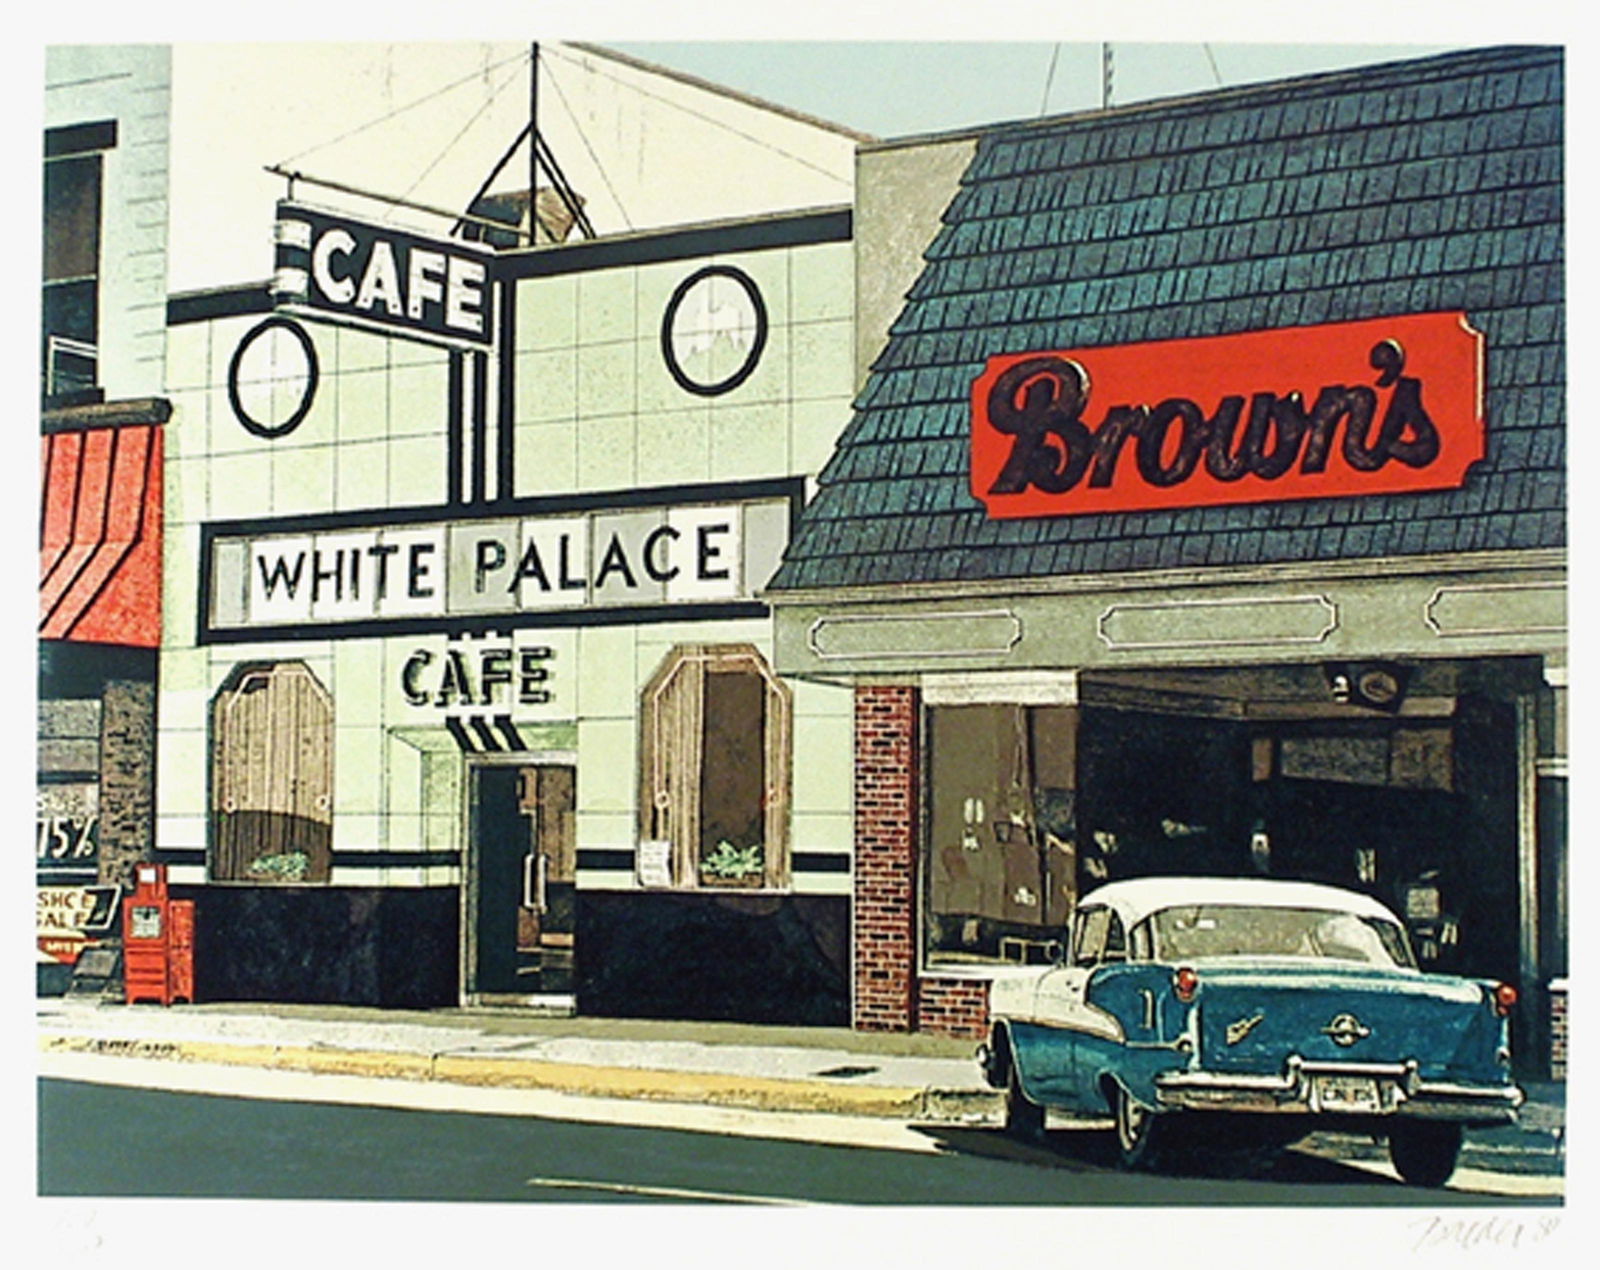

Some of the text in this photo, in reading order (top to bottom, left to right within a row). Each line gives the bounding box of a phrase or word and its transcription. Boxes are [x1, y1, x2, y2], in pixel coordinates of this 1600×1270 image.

[313, 228, 486, 334] CAFE
[987, 338, 1441, 494] Brown's
[257, 522, 732, 602] WHITE PALACE
[402, 646, 554, 708] CAFE
